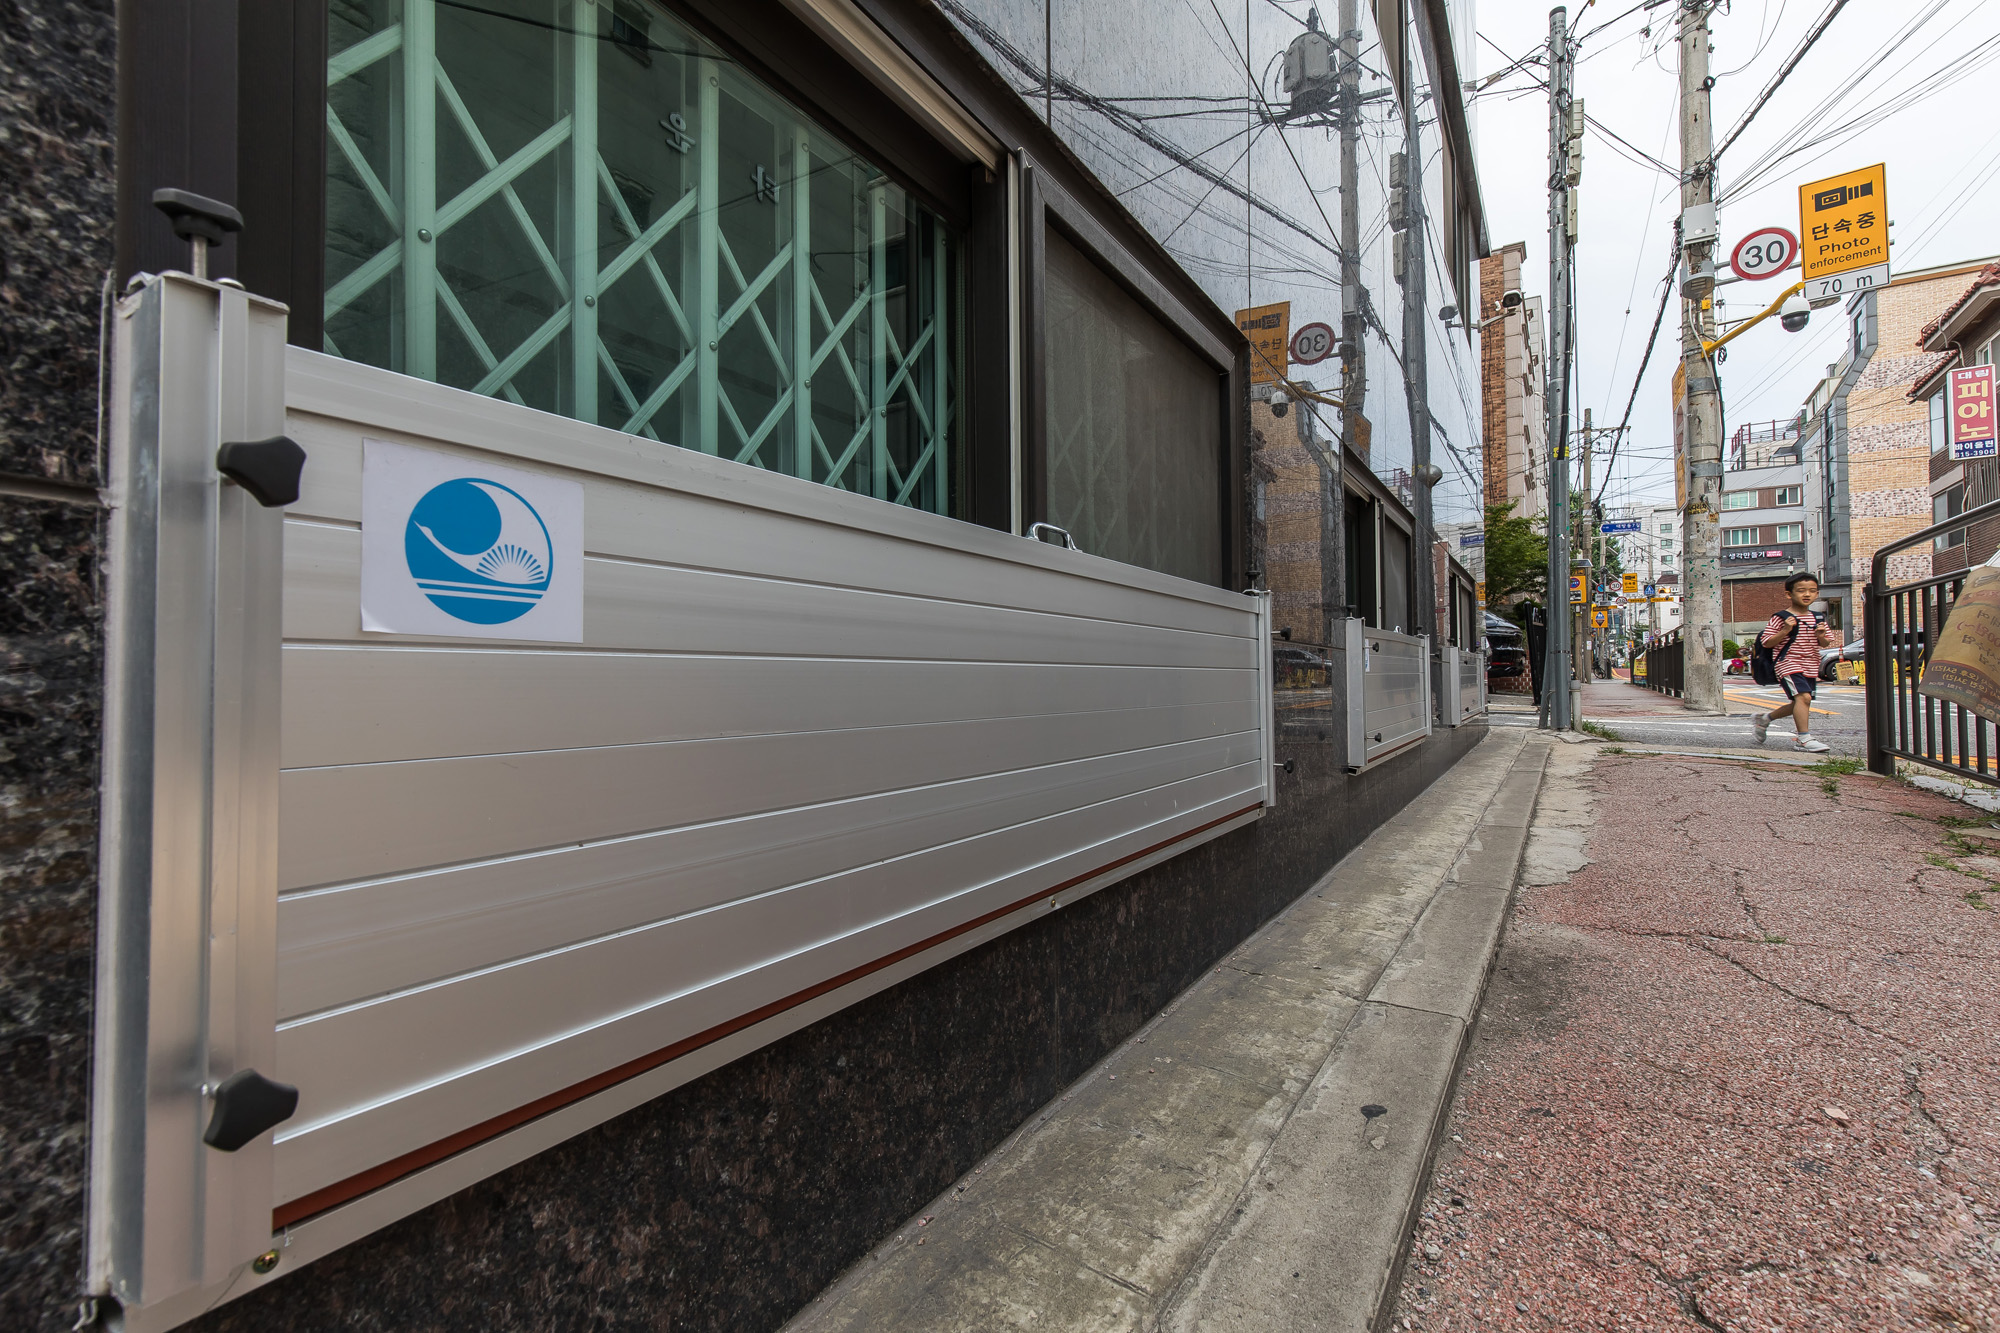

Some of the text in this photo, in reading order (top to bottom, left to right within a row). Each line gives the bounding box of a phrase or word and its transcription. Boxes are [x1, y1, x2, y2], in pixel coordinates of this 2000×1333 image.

[1811, 211, 1876, 241] 단속중
[1744, 240, 1785, 269] 30
[1809, 245, 1882, 270] enforcement
[1819, 237, 1870, 256] Photo
[1819, 274, 1873, 295] 70 m
[1957, 380, 1992, 440] 피아노
[1954, 439, 1994, 451] 바이올린
